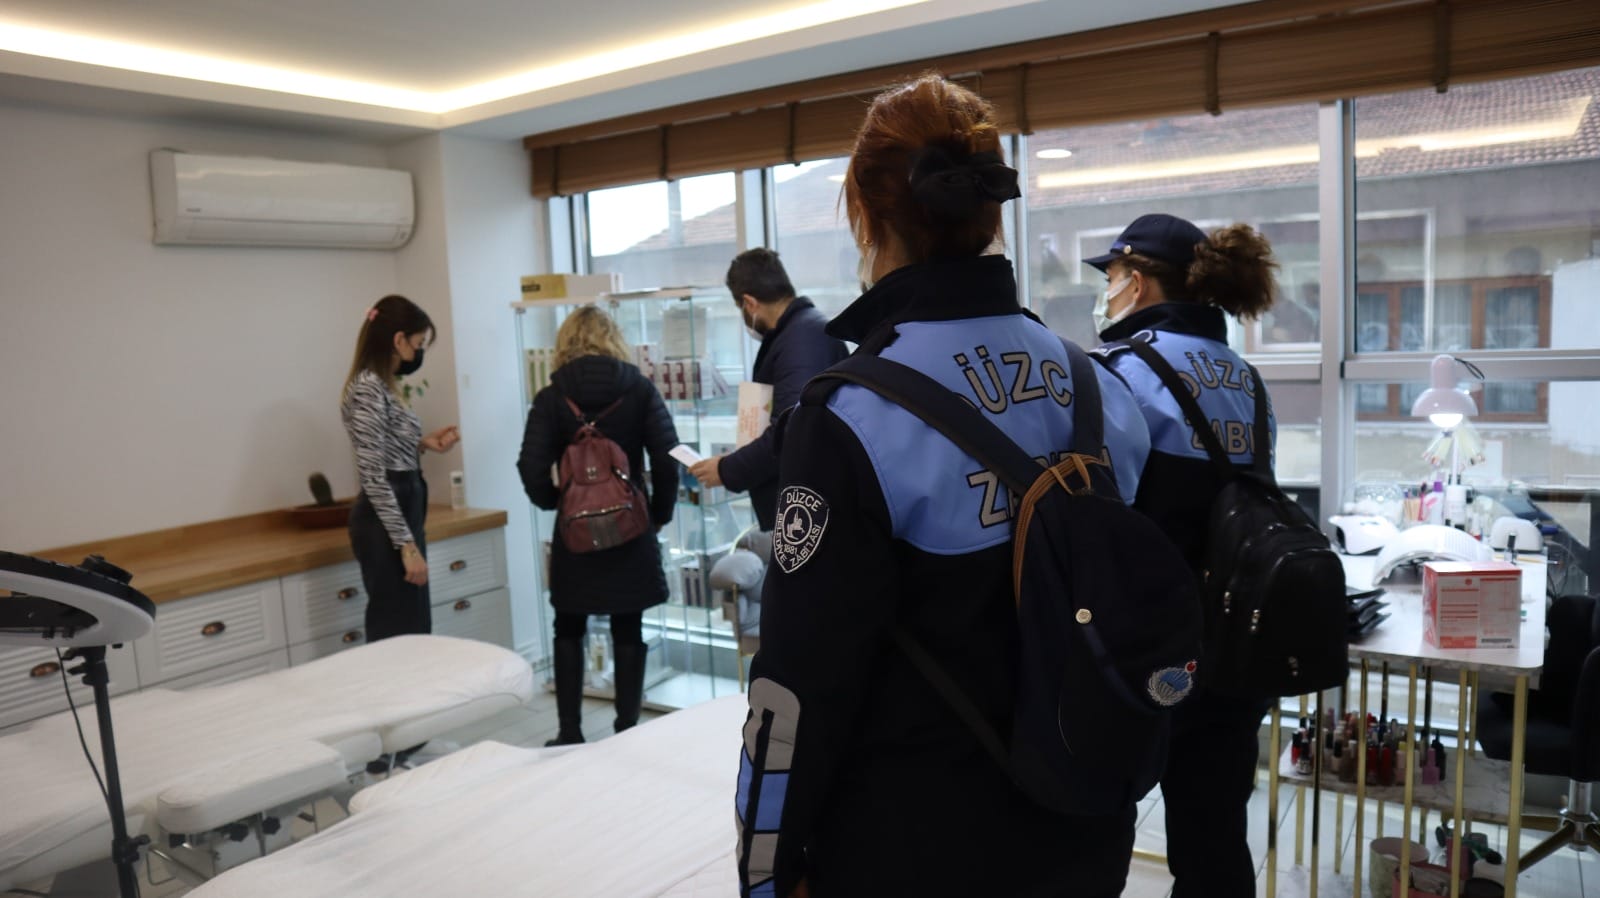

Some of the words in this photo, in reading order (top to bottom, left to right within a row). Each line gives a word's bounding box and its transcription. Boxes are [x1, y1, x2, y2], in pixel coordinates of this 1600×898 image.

[953, 345, 1074, 414] ÜZC
[786, 488, 822, 512] DÜZCE
[789, 523, 822, 568] ZABITASI
